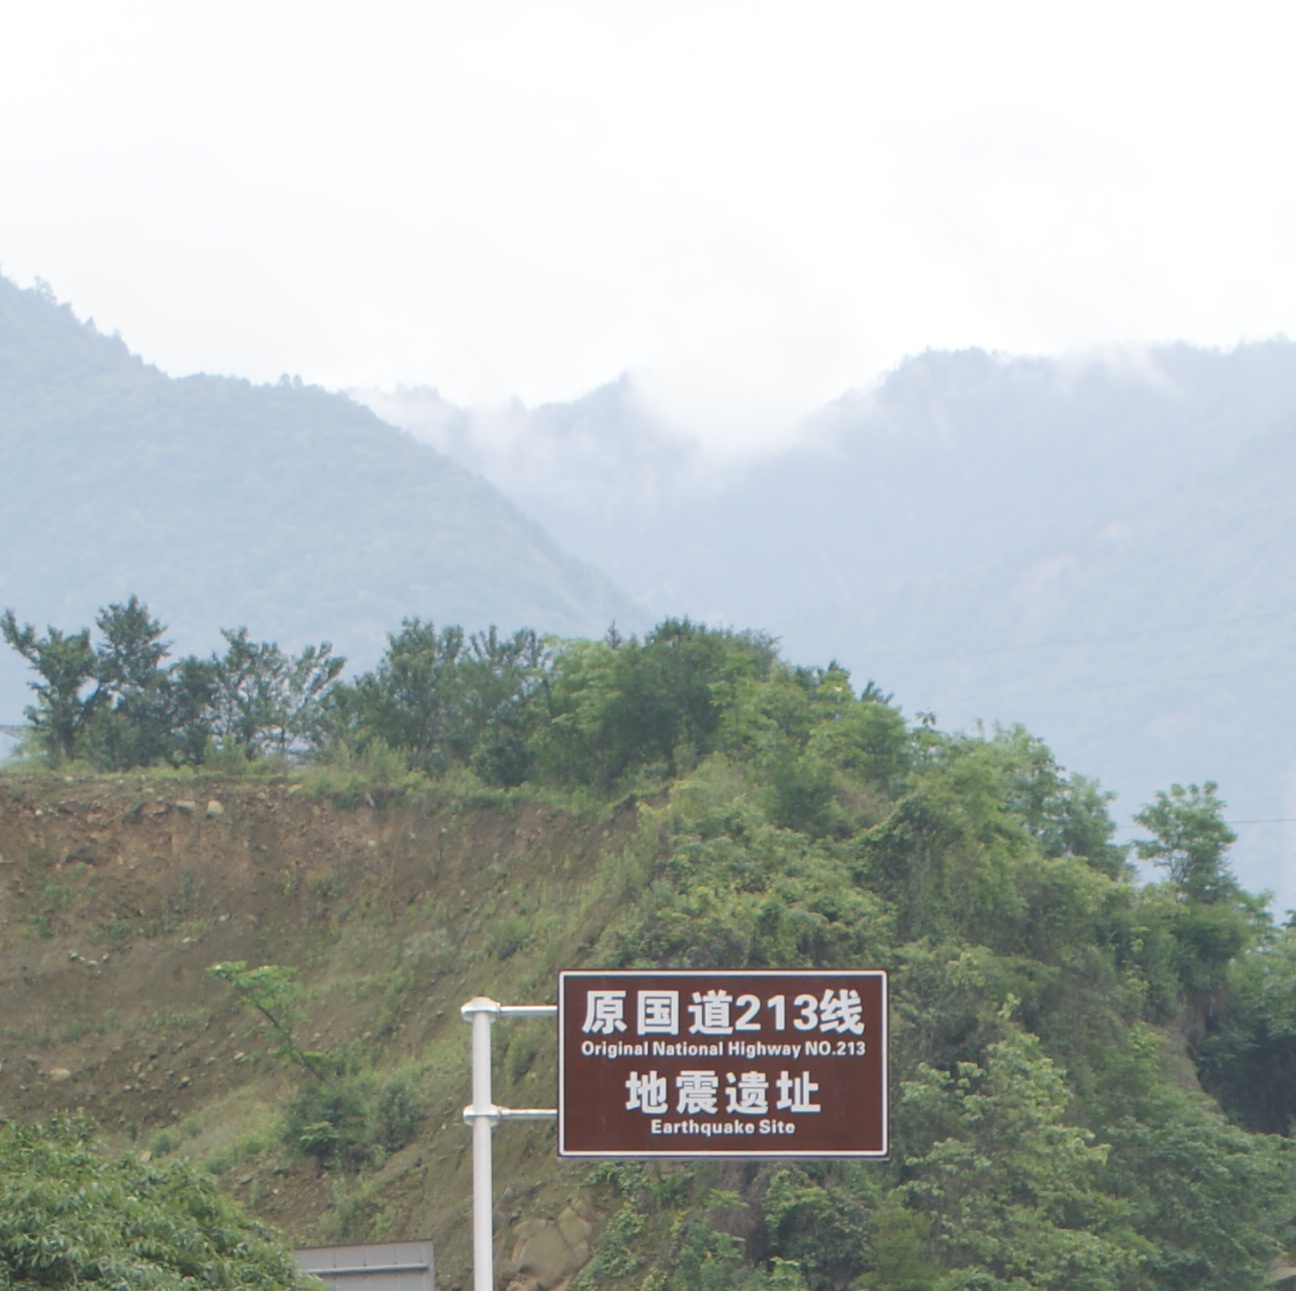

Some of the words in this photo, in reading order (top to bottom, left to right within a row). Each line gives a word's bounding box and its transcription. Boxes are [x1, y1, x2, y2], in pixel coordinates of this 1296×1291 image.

[581, 989, 865, 1035] 原国道213线
[581, 1041, 648, 1059] Original
[653, 1041, 723, 1056] National
[728, 1041, 801, 1059] Highway
[804, 1041, 866, 1056] NO.213
[625, 1070, 821, 1115] 地震遗址
[651, 1119, 755, 1137] Earthquake
[759, 1119, 795, 1134] Site
